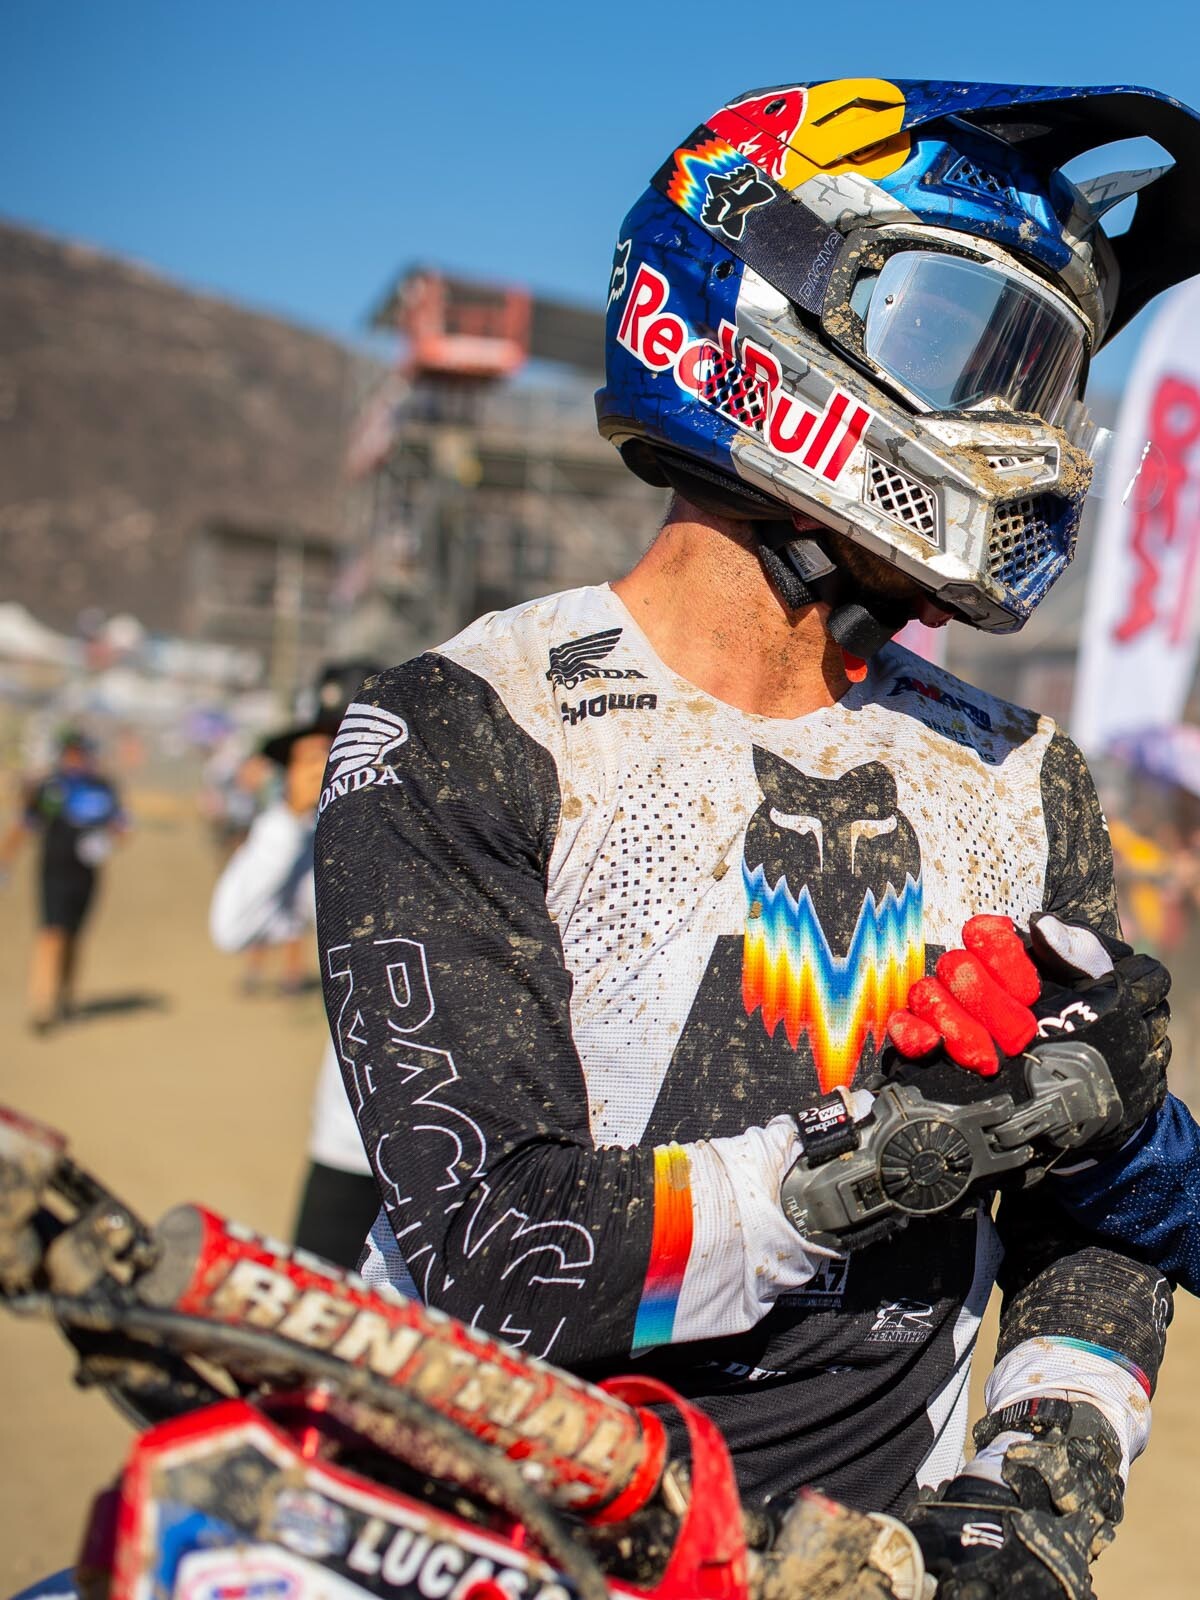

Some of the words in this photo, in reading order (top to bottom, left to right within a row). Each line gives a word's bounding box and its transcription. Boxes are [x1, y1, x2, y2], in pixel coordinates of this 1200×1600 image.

[619, 266, 737, 402] Red
[726, 344, 871, 482] Bull
[317, 765, 403, 816] ONDA
